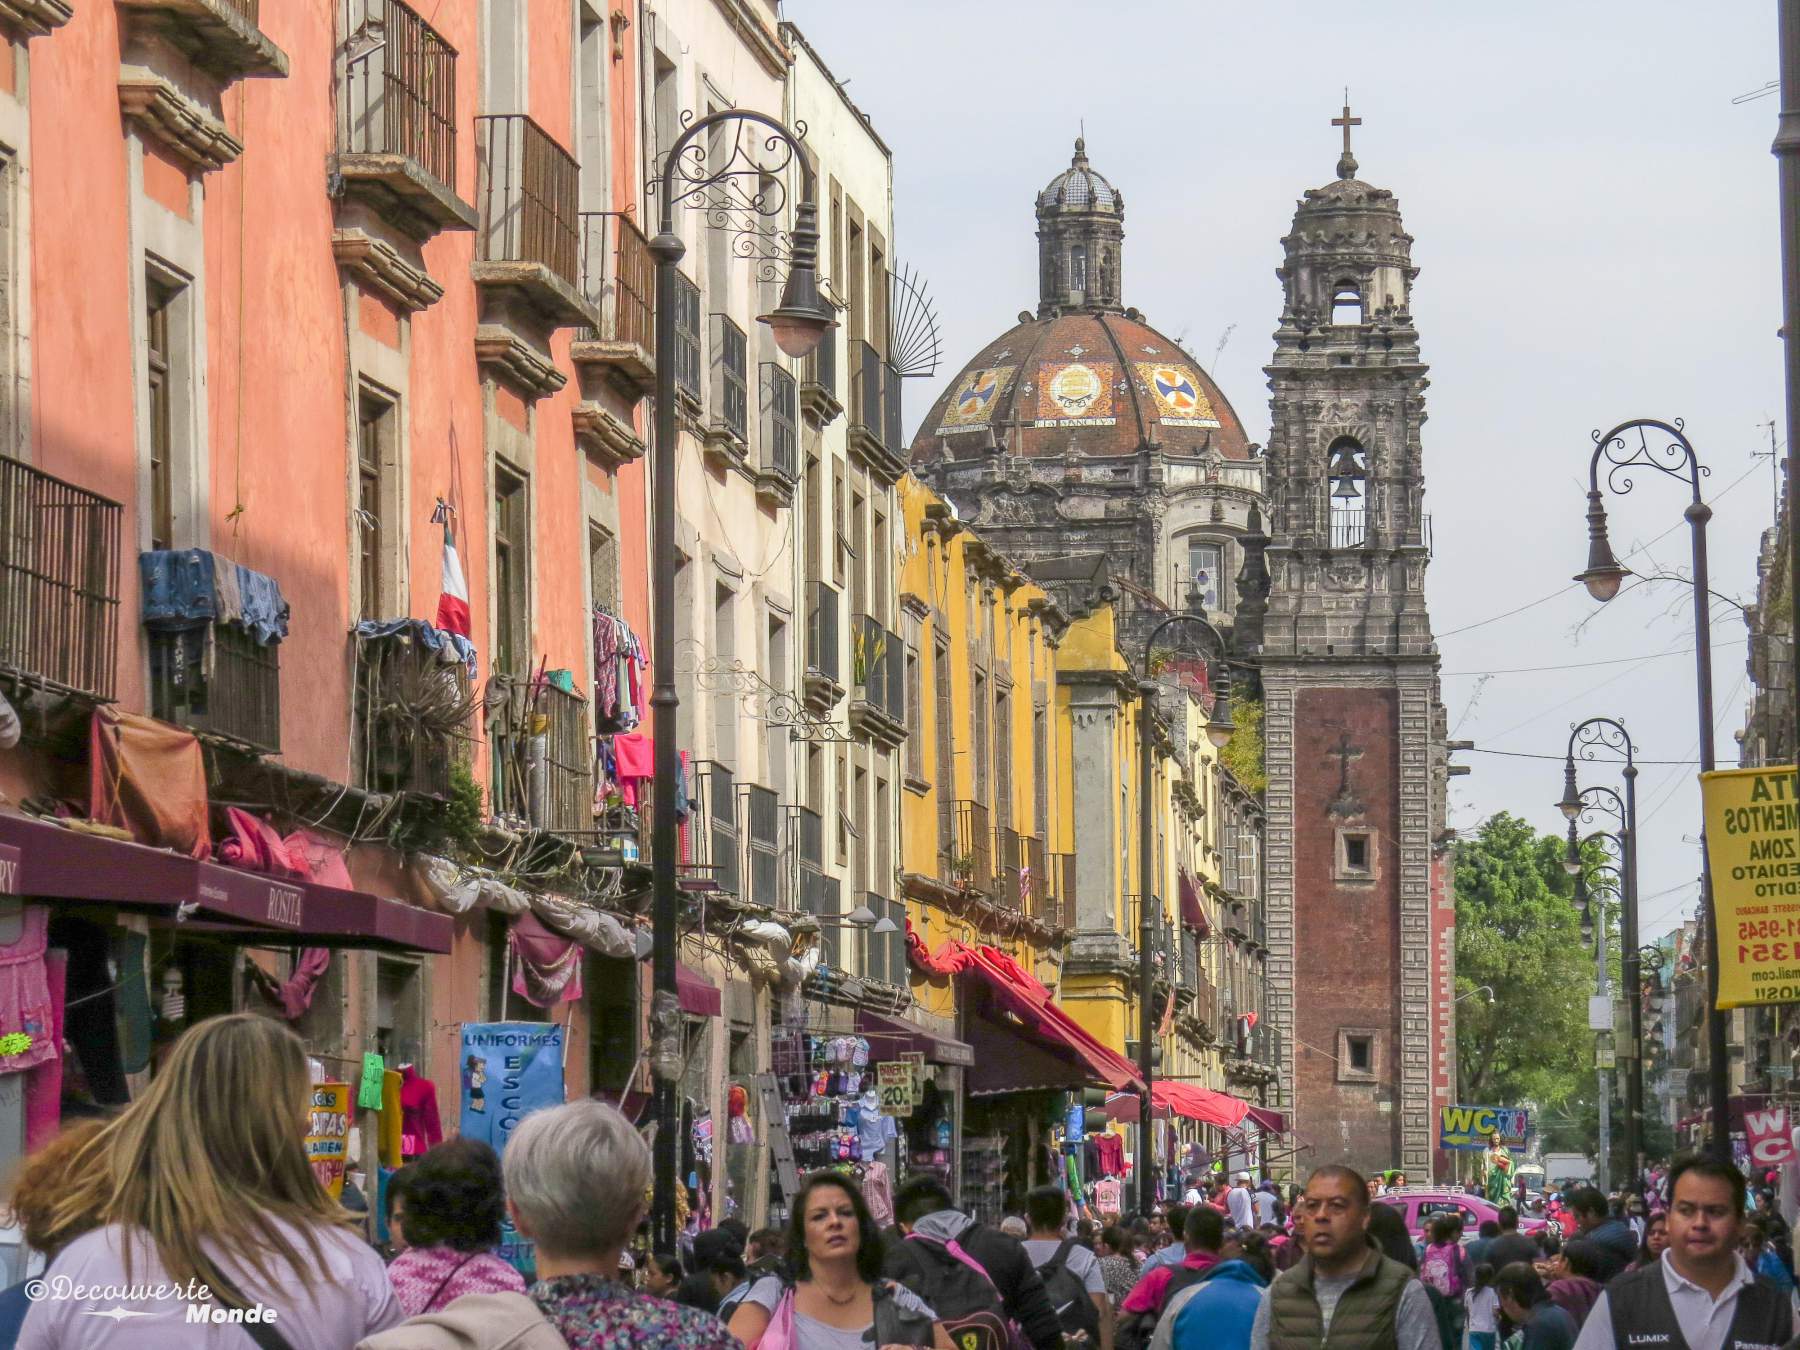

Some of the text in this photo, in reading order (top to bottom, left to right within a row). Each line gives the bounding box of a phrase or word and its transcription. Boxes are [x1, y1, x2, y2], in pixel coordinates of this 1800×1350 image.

[267, 887, 301, 926] ROSITA
[464, 1034, 561, 1047] UNIFORMES
[884, 1086, 903, 1105] 20
[1442, 1106, 1496, 1134] WC
[1628, 1334, 1669, 1344] LUMIX
